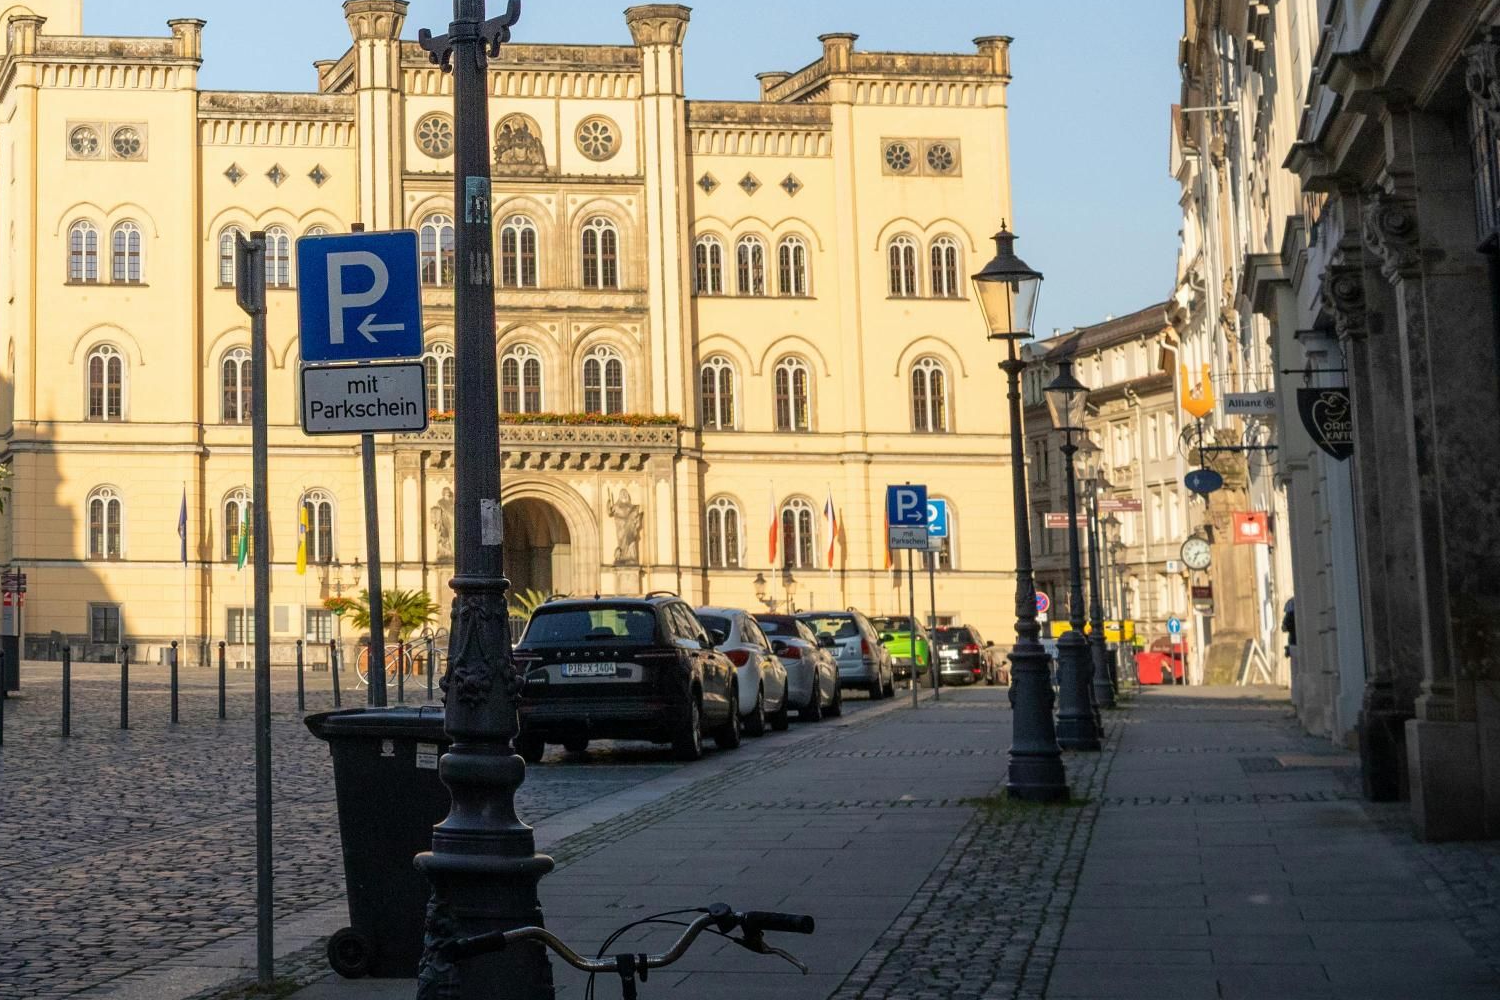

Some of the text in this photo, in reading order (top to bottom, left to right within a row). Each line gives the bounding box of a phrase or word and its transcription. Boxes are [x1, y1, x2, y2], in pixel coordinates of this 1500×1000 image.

[326, 250, 390, 345] P
[347, 374, 379, 394] mit
[310, 397, 418, 420] Parkschein
[1228, 398, 1262, 408] Allianz
[896, 489, 918, 521] P
[891, 536, 926, 545] Parkschein
